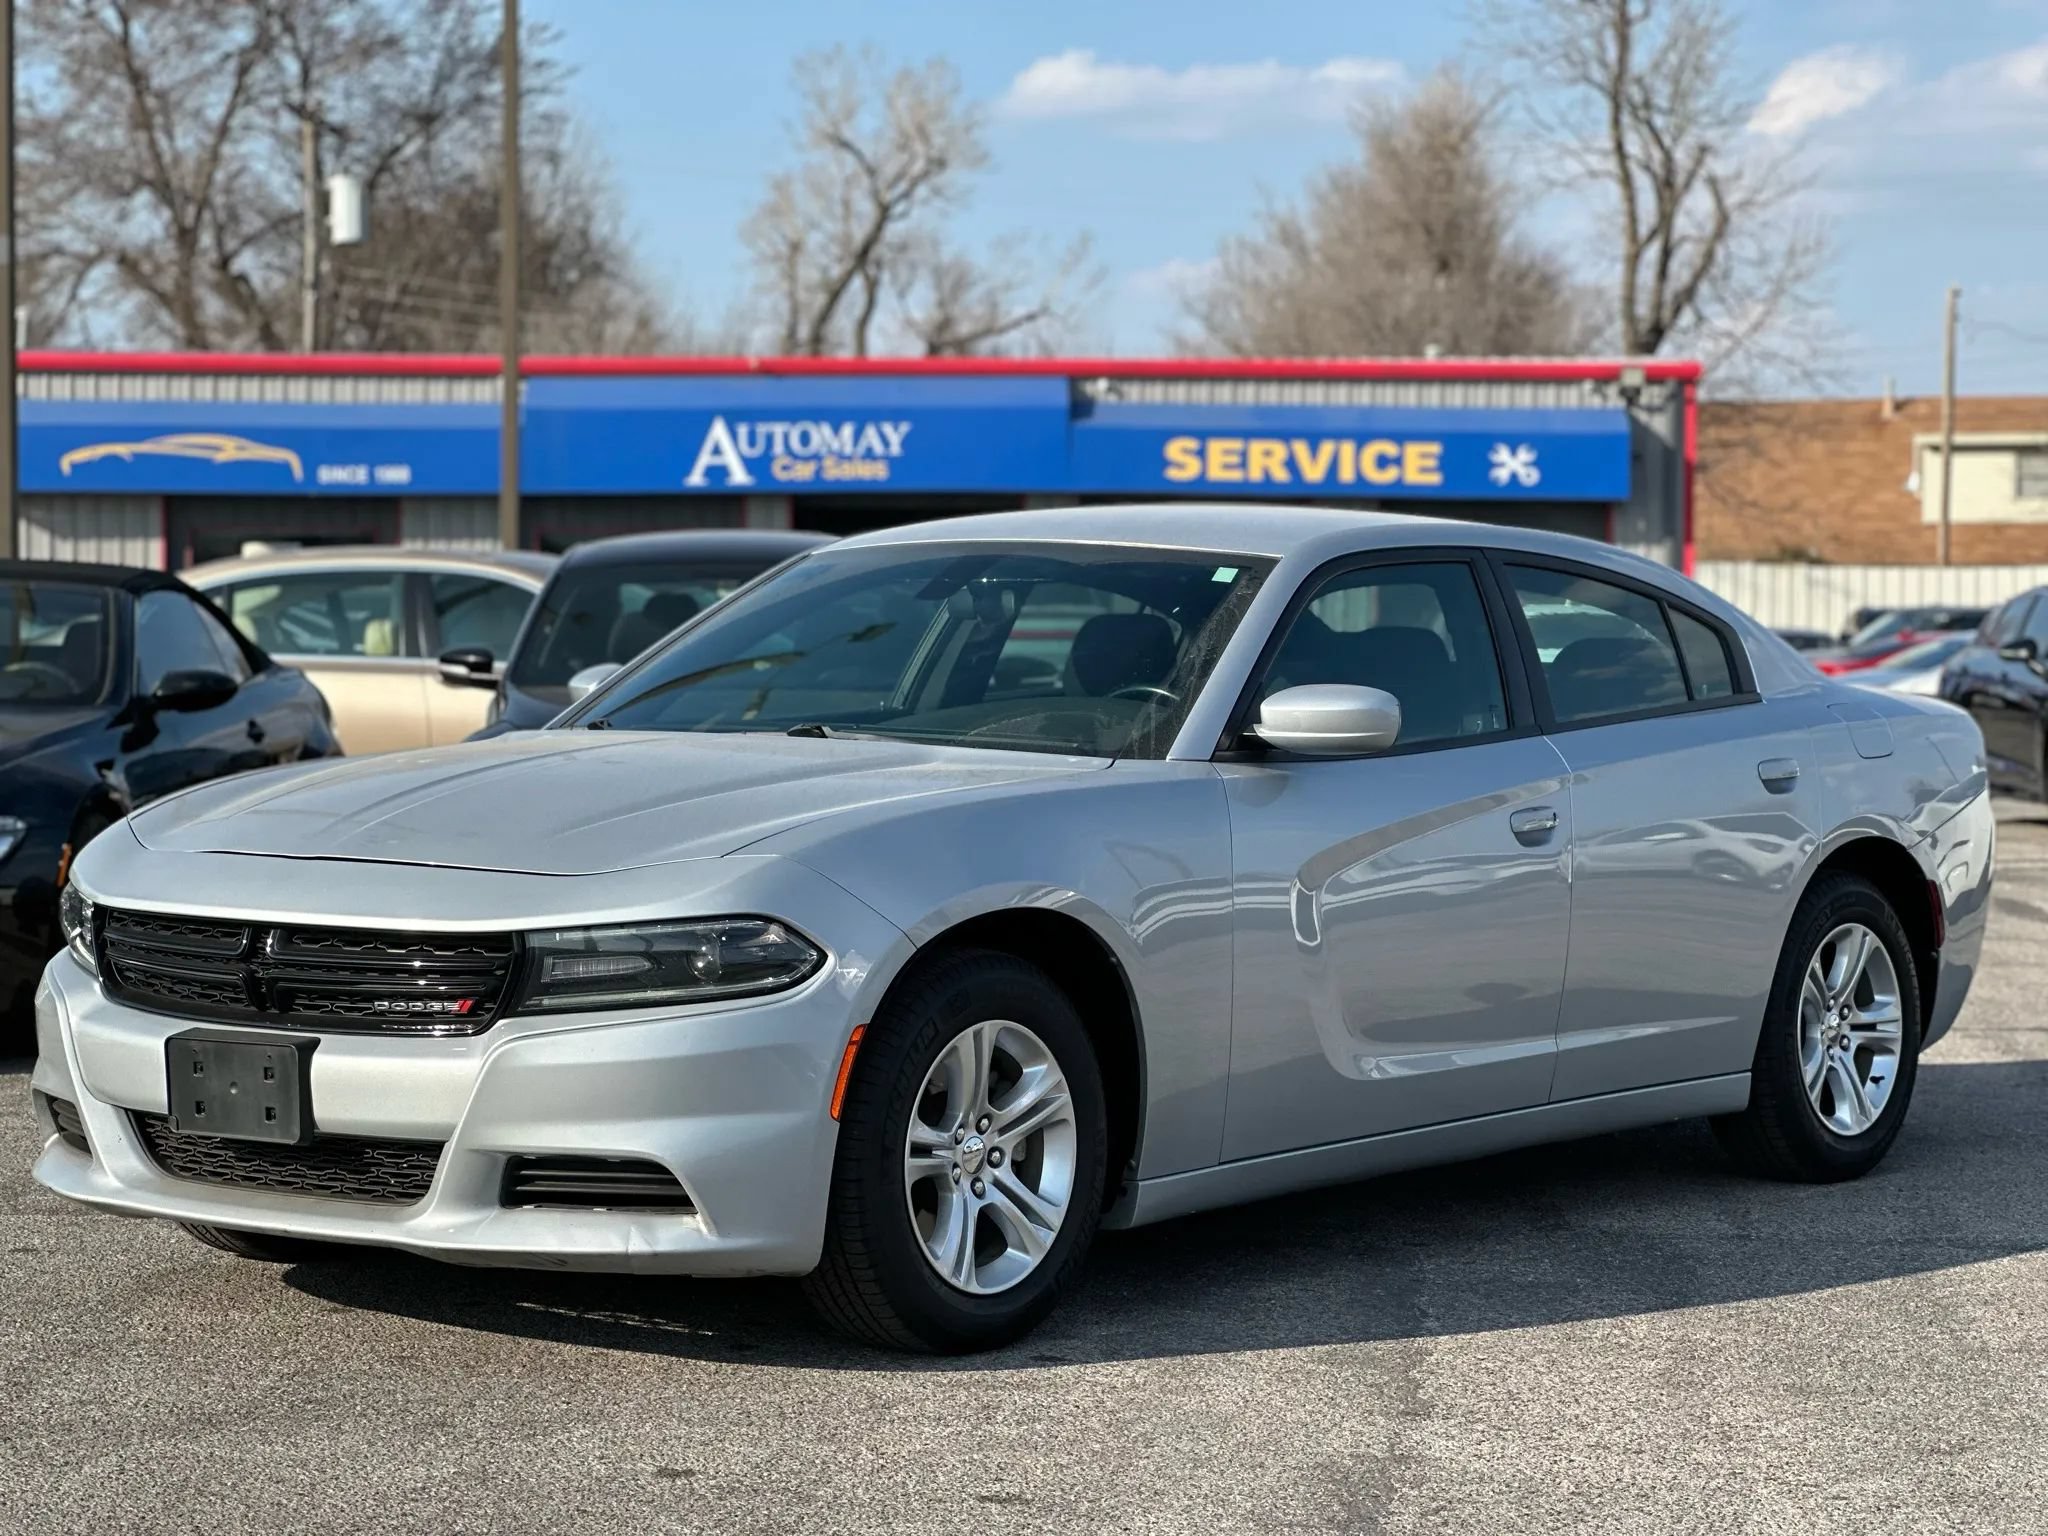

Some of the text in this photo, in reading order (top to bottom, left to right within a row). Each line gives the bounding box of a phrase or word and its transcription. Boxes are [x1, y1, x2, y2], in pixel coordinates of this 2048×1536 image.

[683, 415, 912, 487] AUTOMAY
[1163, 435, 1443, 486] SERVICE
[316, 464, 369, 485] SINCE
[771, 456, 889, 482] Car Sales
[374, 1001, 460, 1012] DODGE
